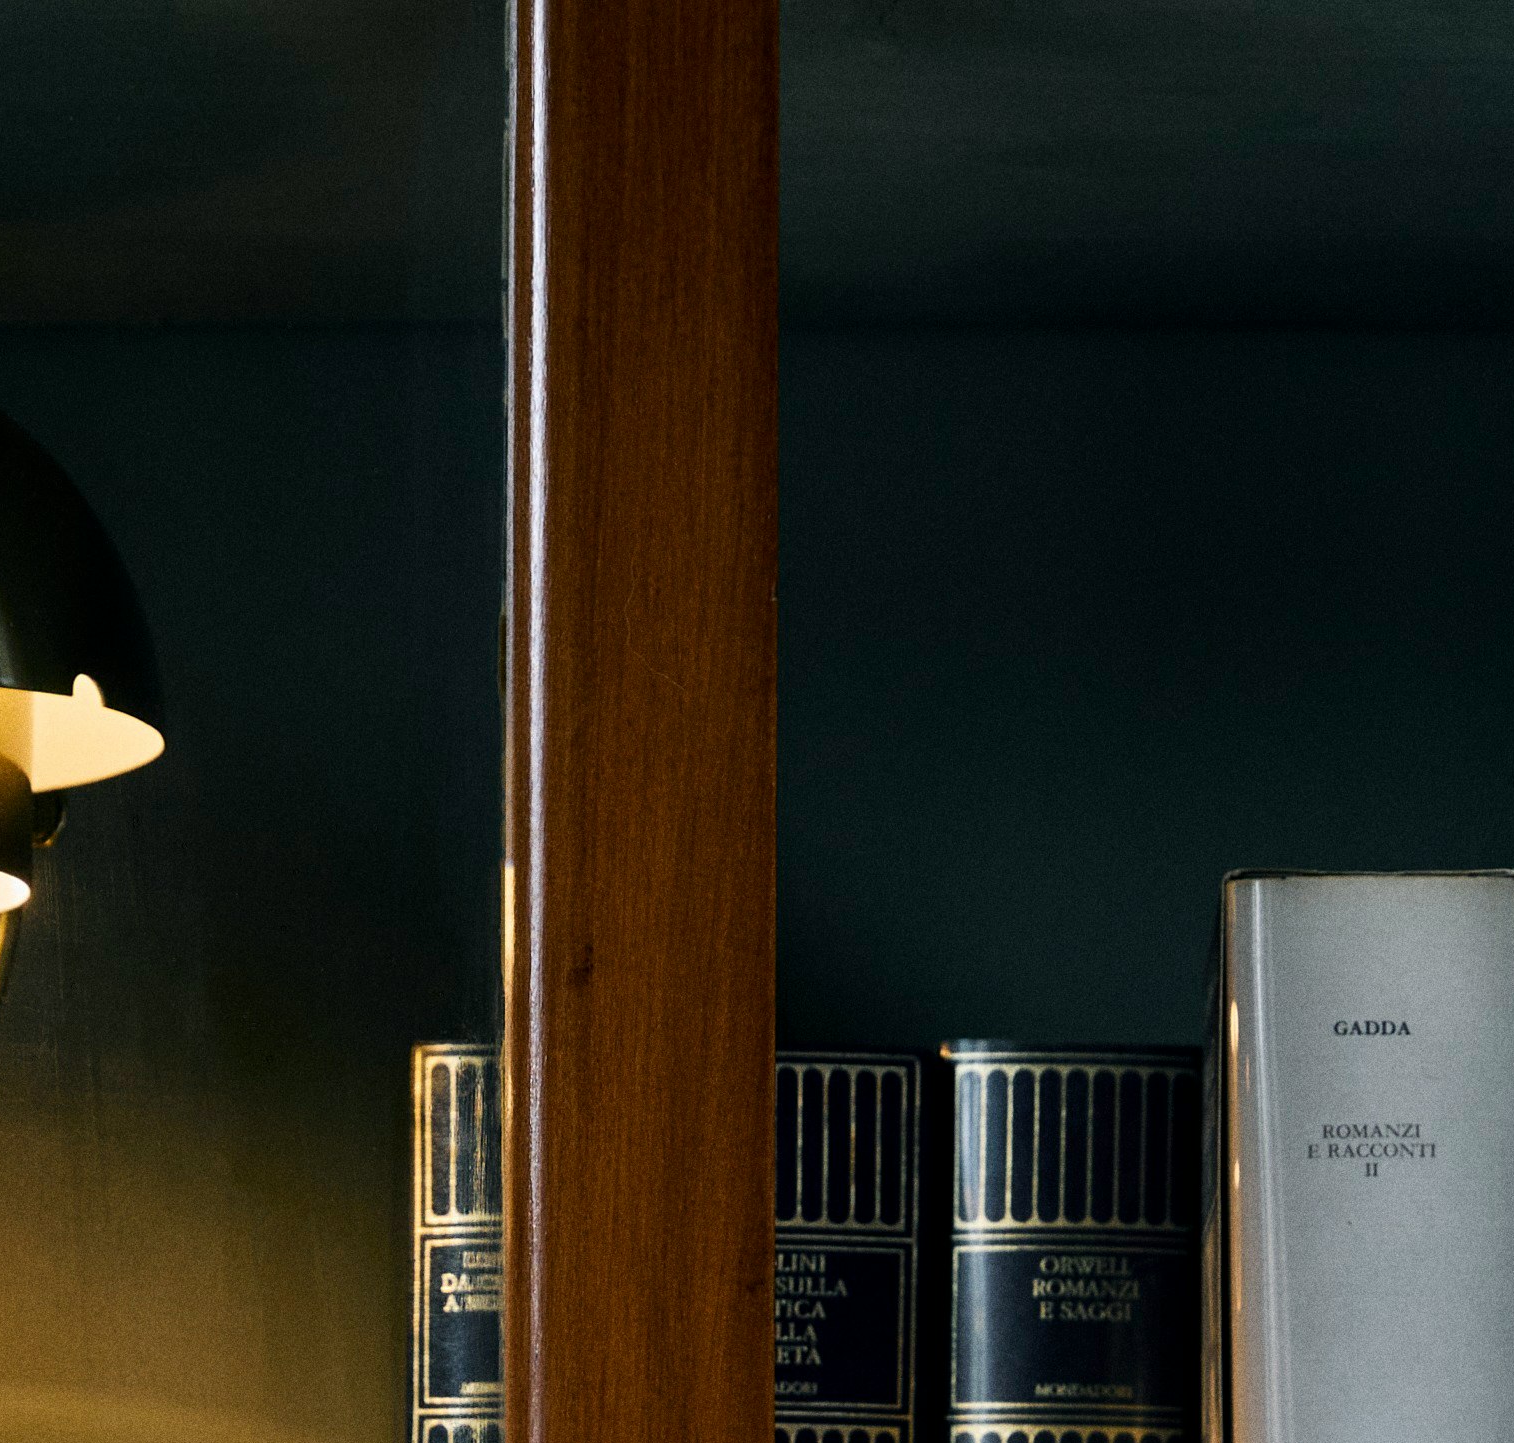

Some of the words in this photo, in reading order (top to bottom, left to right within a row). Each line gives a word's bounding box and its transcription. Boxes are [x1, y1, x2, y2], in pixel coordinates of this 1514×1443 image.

[1333, 1020, 1411, 1036] GADDA
[1322, 1123, 1421, 1139] ROMANZI
[1307, 1143, 1320, 1159] E
[1327, 1142, 1437, 1159] RACCONTI
[1365, 1162, 1379, 1177] II
[1039, 1255, 1132, 1276] ORWELL
[1032, 1277, 1140, 1299] ROMANZI
[1039, 1301, 1054, 1321] E
[1059, 1301, 1132, 1322] SAGGI
